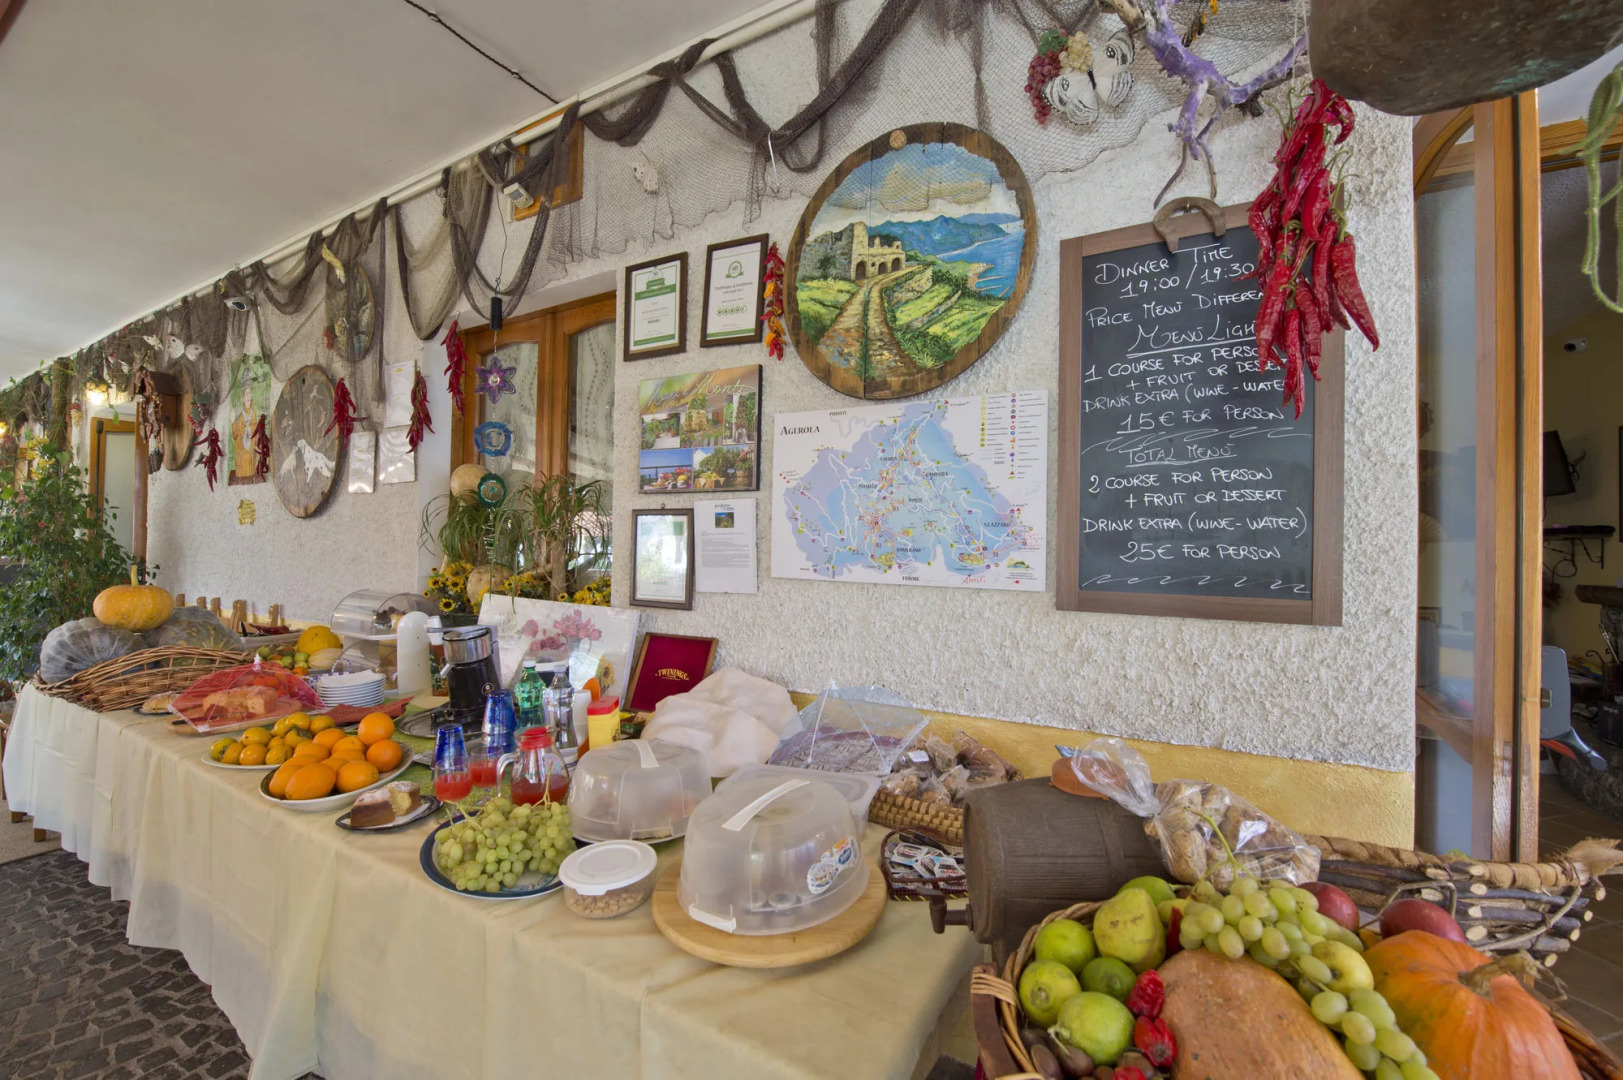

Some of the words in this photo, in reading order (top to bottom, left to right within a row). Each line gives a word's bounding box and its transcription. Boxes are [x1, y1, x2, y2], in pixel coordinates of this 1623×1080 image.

[1094, 258, 1170, 285] DINNER
[1171, 242, 1234, 264] TIME
[1120, 276, 1180, 299] 19:00
[1200, 262, 1255, 285] 19:30
[1085, 306, 1133, 329] PRICE
[1191, 289, 1265, 310] DIFFEREN
[1206, 313, 1257, 340] LIGH
[1083, 364, 1103, 383] 1
[1107, 358, 1165, 377] COURSE
[1172, 352, 1204, 366] FOR
[1210, 345, 1259, 361] PERSO
[1145, 371, 1197, 388] FRUIT
[1207, 363, 1229, 377] OR
[1082, 395, 1131, 413] DRINK
[1134, 388, 1180, 405] EXTRA
[1242, 379, 1285, 392] WATE
[1182, 408, 1212, 424] FOR
[1223, 404, 1285, 421] PERSON
[780, 425, 821, 436] AGEROLA
[1118, 444, 1177, 464] TOTAL
[1088, 475, 1101, 494] 2
[1105, 474, 1161, 489] COURSE
[1171, 471, 1204, 484] FOR
[1210, 467, 1273, 482] PERSON
[1143, 492, 1188, 507] FRUIT
[1194, 491, 1218, 504] OR
[1220, 489, 1288, 502] DESSERT
[1082, 517, 1133, 533] DRINK
[1138, 517, 1183, 530] EXTRA
[1181, 543, 1211, 557] FOR
[1216, 543, 1281, 560] PERSON
[658, 668, 688, 681] TWININGS
